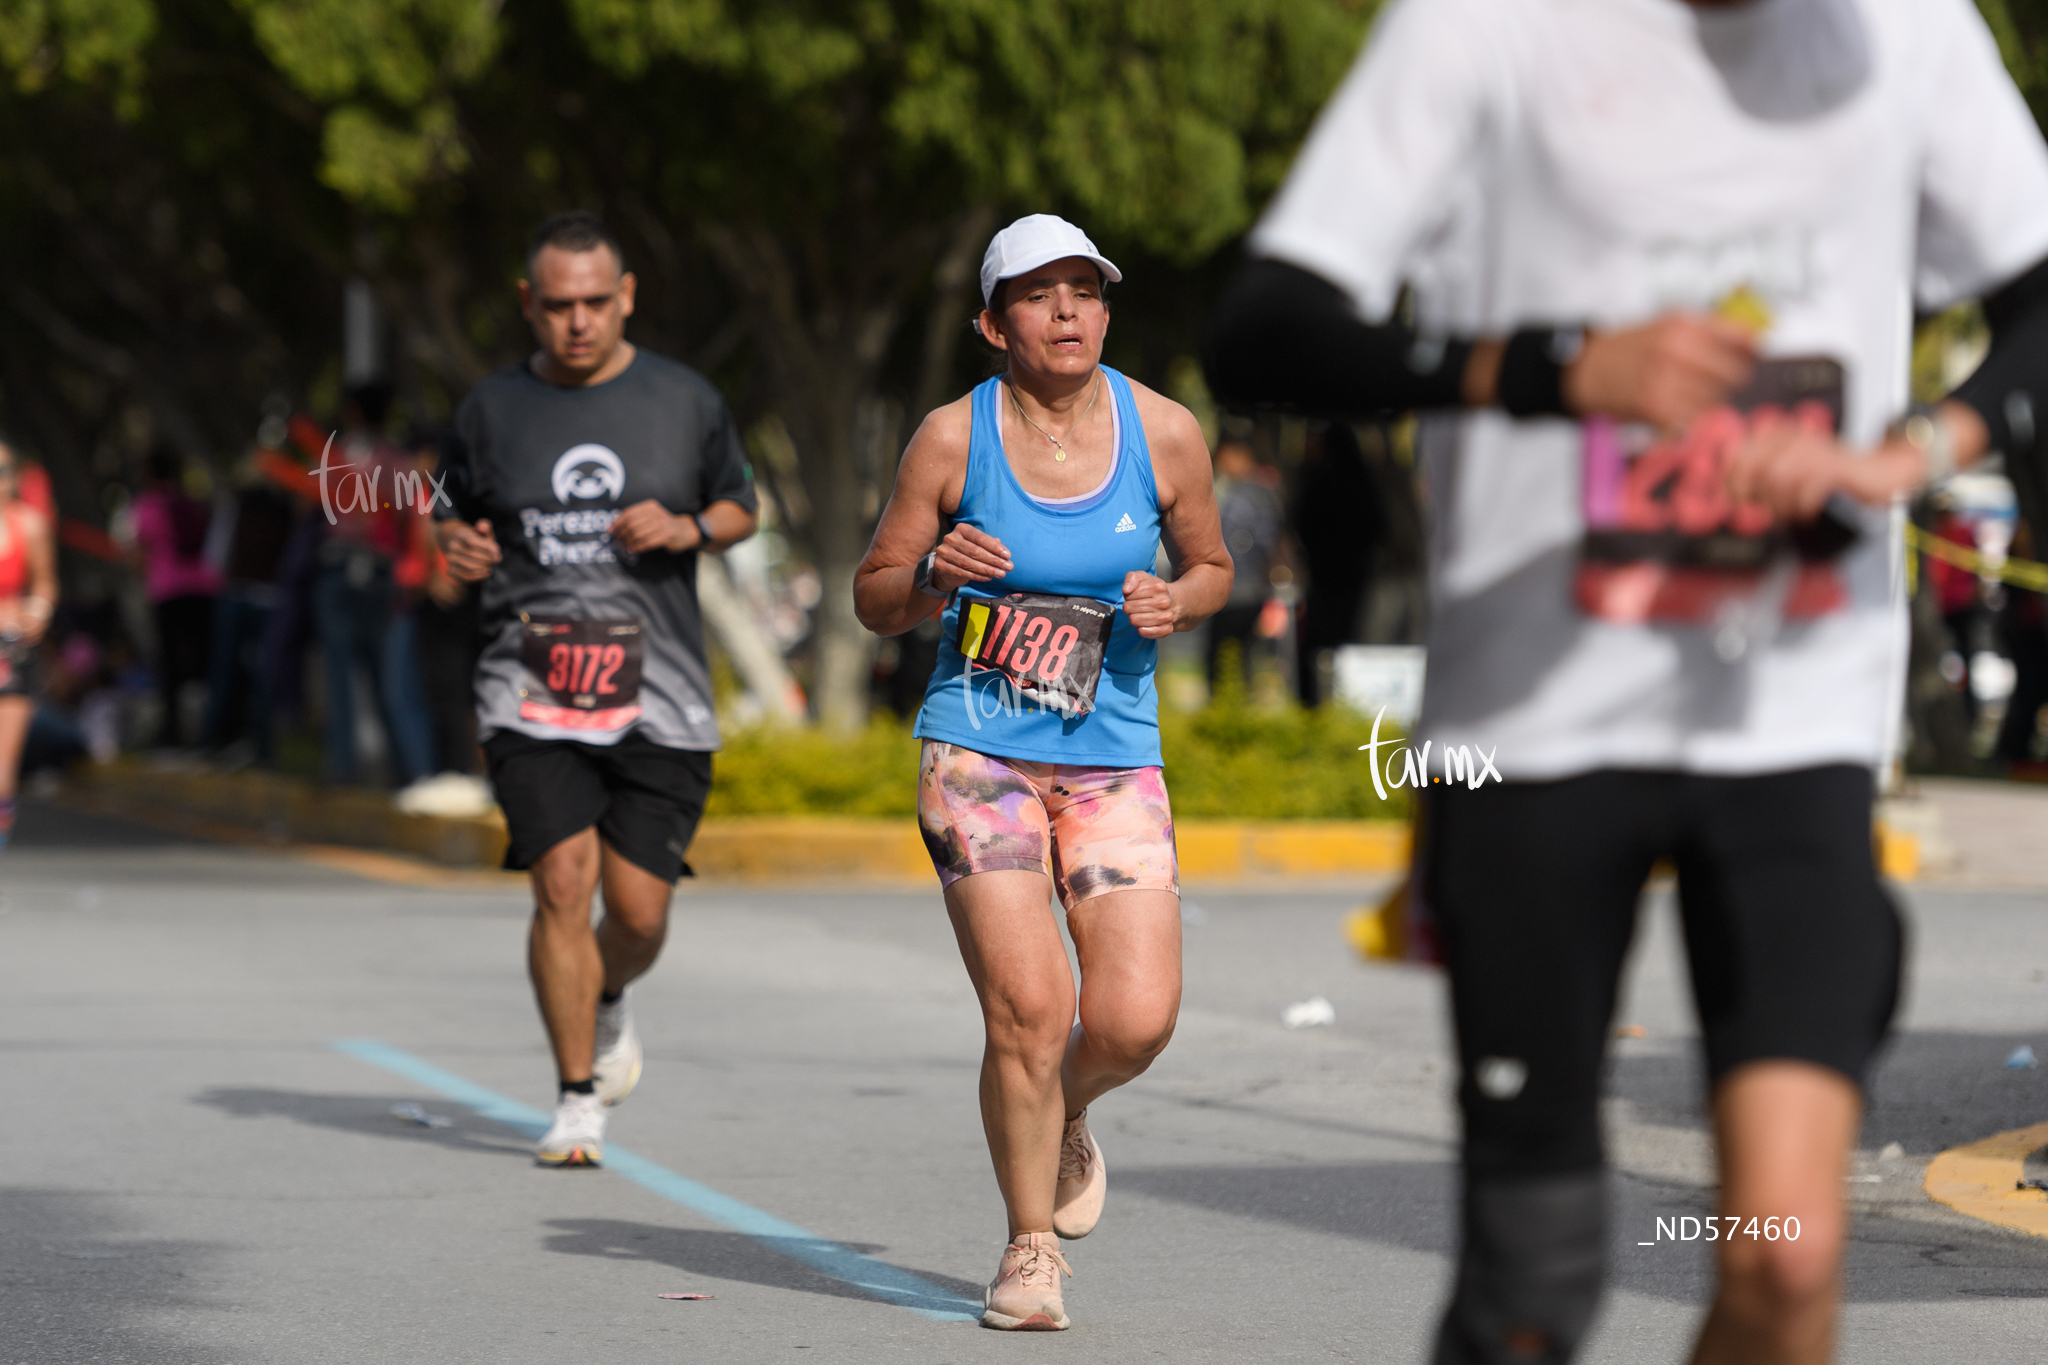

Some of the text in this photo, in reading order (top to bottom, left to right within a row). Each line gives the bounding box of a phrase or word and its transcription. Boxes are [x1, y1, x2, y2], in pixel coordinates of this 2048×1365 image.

[1115, 524, 1137, 533] adidas
[547, 643, 625, 695] 3172
[982, 605, 1079, 681] 1138
